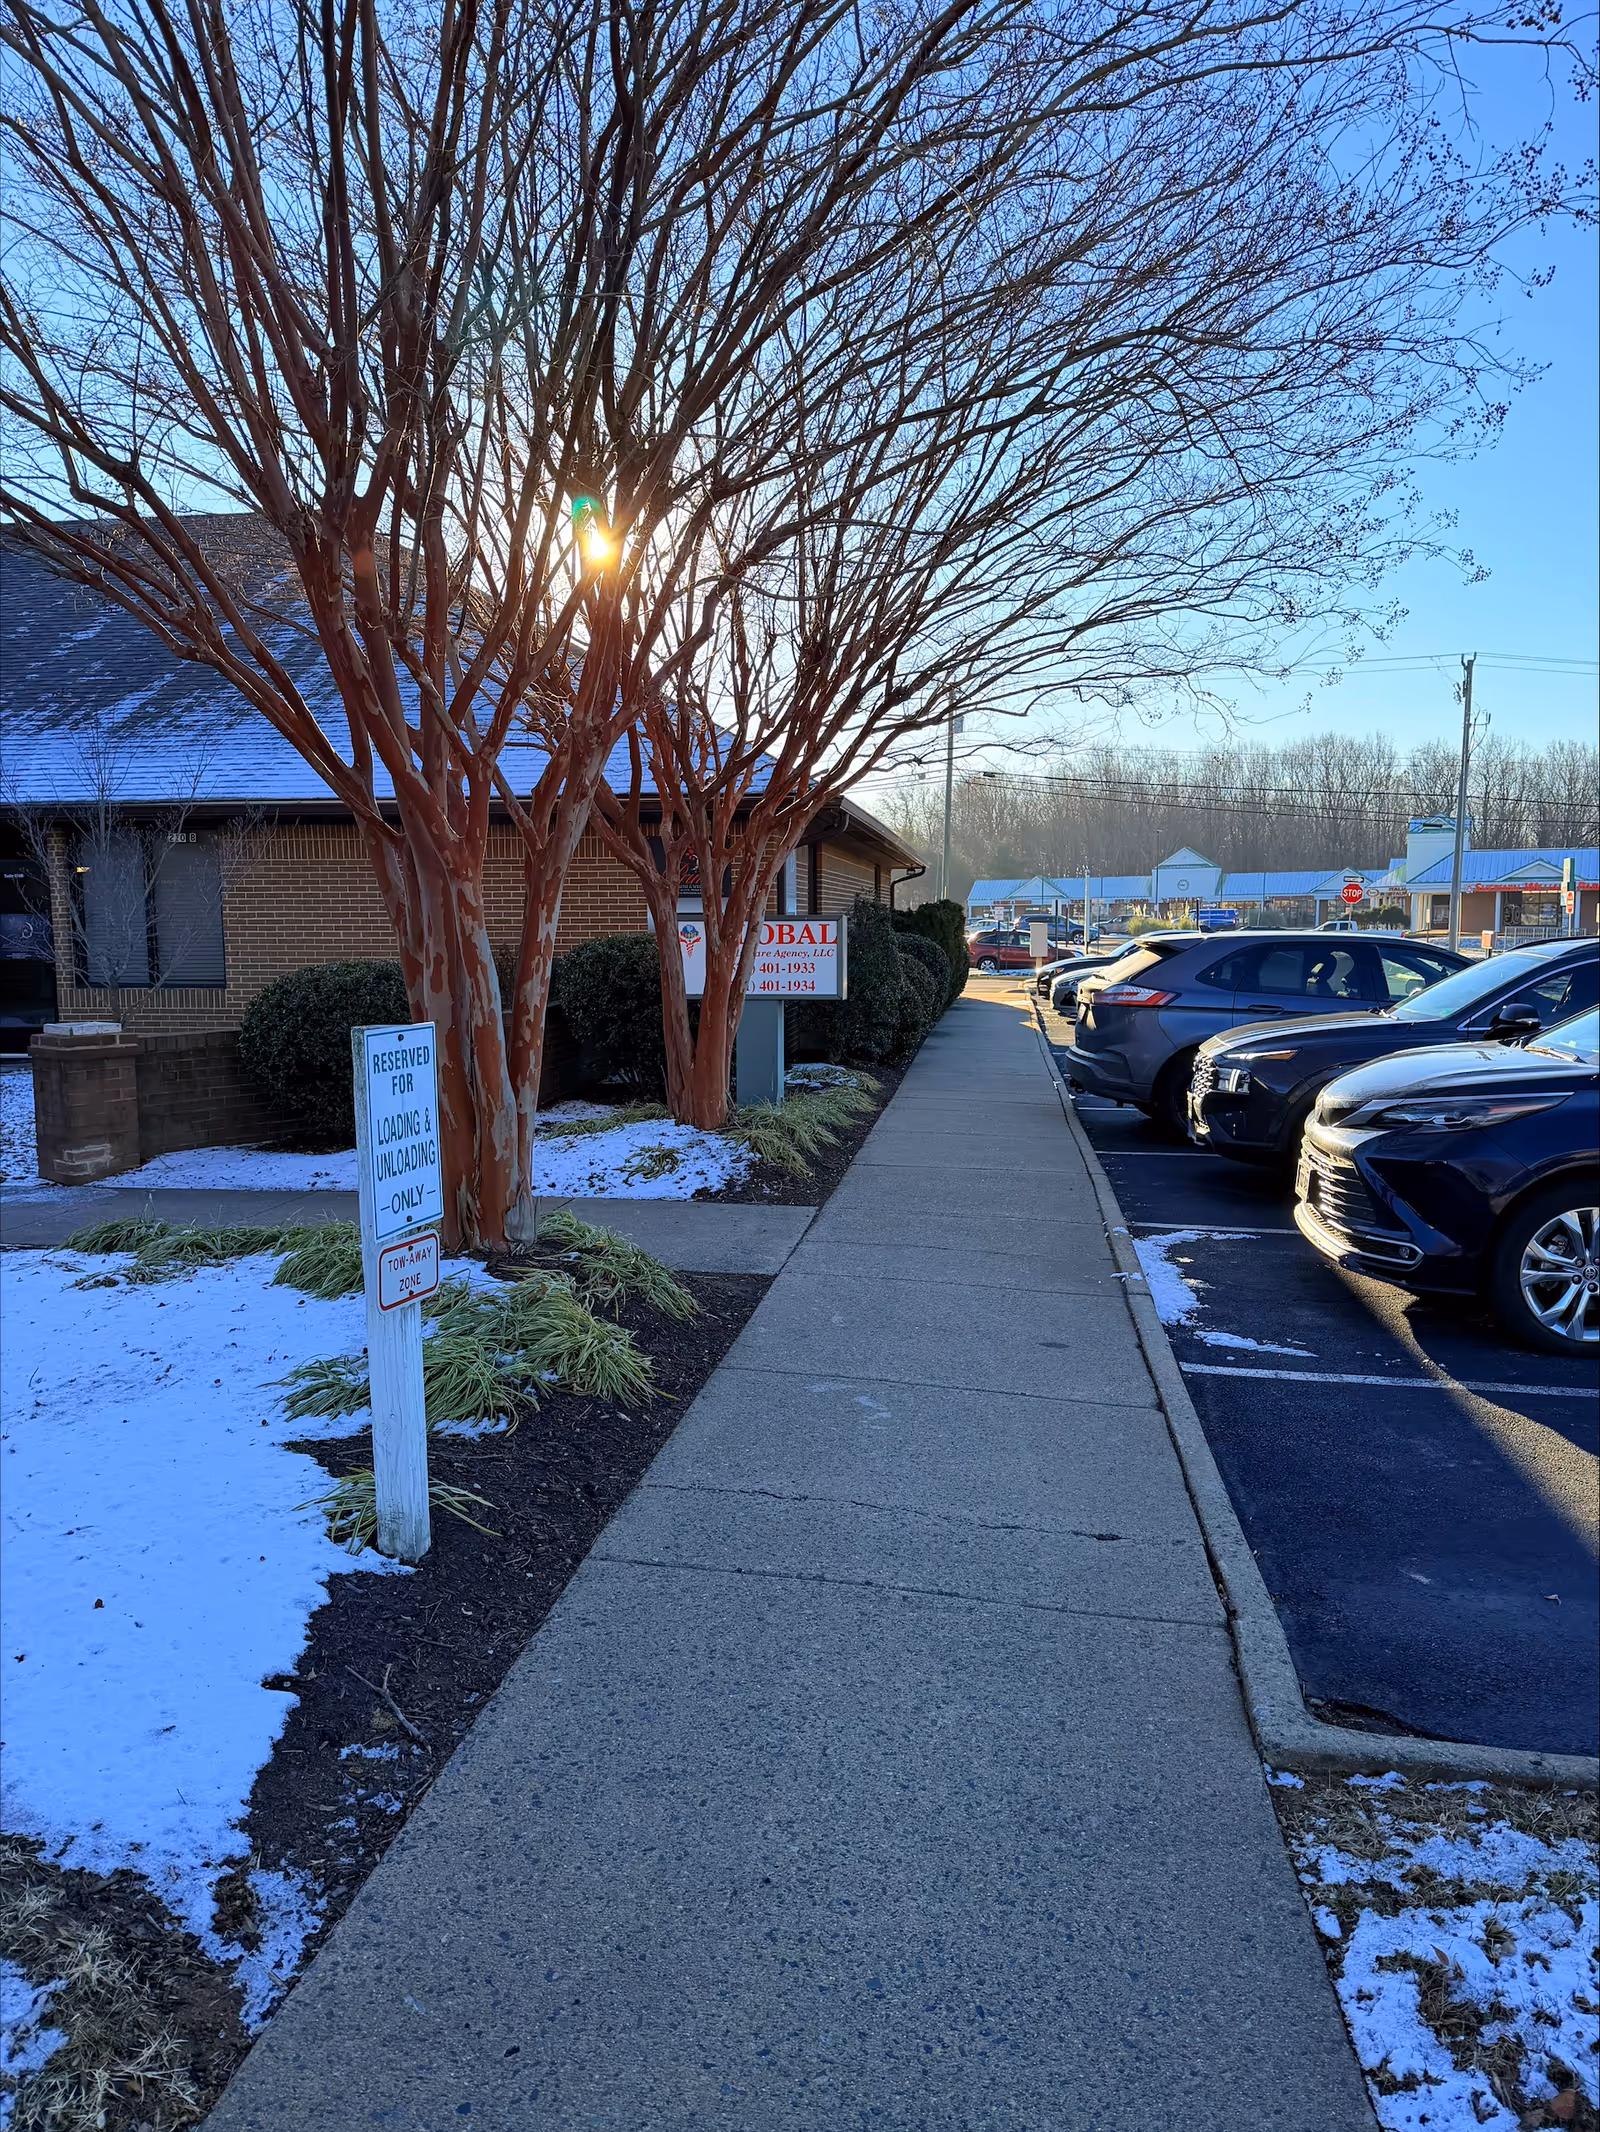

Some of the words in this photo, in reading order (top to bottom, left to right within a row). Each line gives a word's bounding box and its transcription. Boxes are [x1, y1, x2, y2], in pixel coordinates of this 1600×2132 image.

[1343, 889, 1362, 897] STOP
[739, 924, 838, 946] OBAL
[774, 949, 810, 959] Agency,
[813, 949, 834, 957] LLC
[759, 963, 815, 974] 401-1933
[759, 980, 815, 991] 401-1934
[373, 1046, 430, 1074] RESERVED
[392, 1073, 413, 1096] FOR
[377, 1109, 420, 1146] LOADING
[424, 1106, 431, 1133] &
[376, 1139, 436, 1182] UNLOADING
[388, 1246, 433, 1273] TOW-AWAY
[399, 1273, 421, 1292] ZONE
